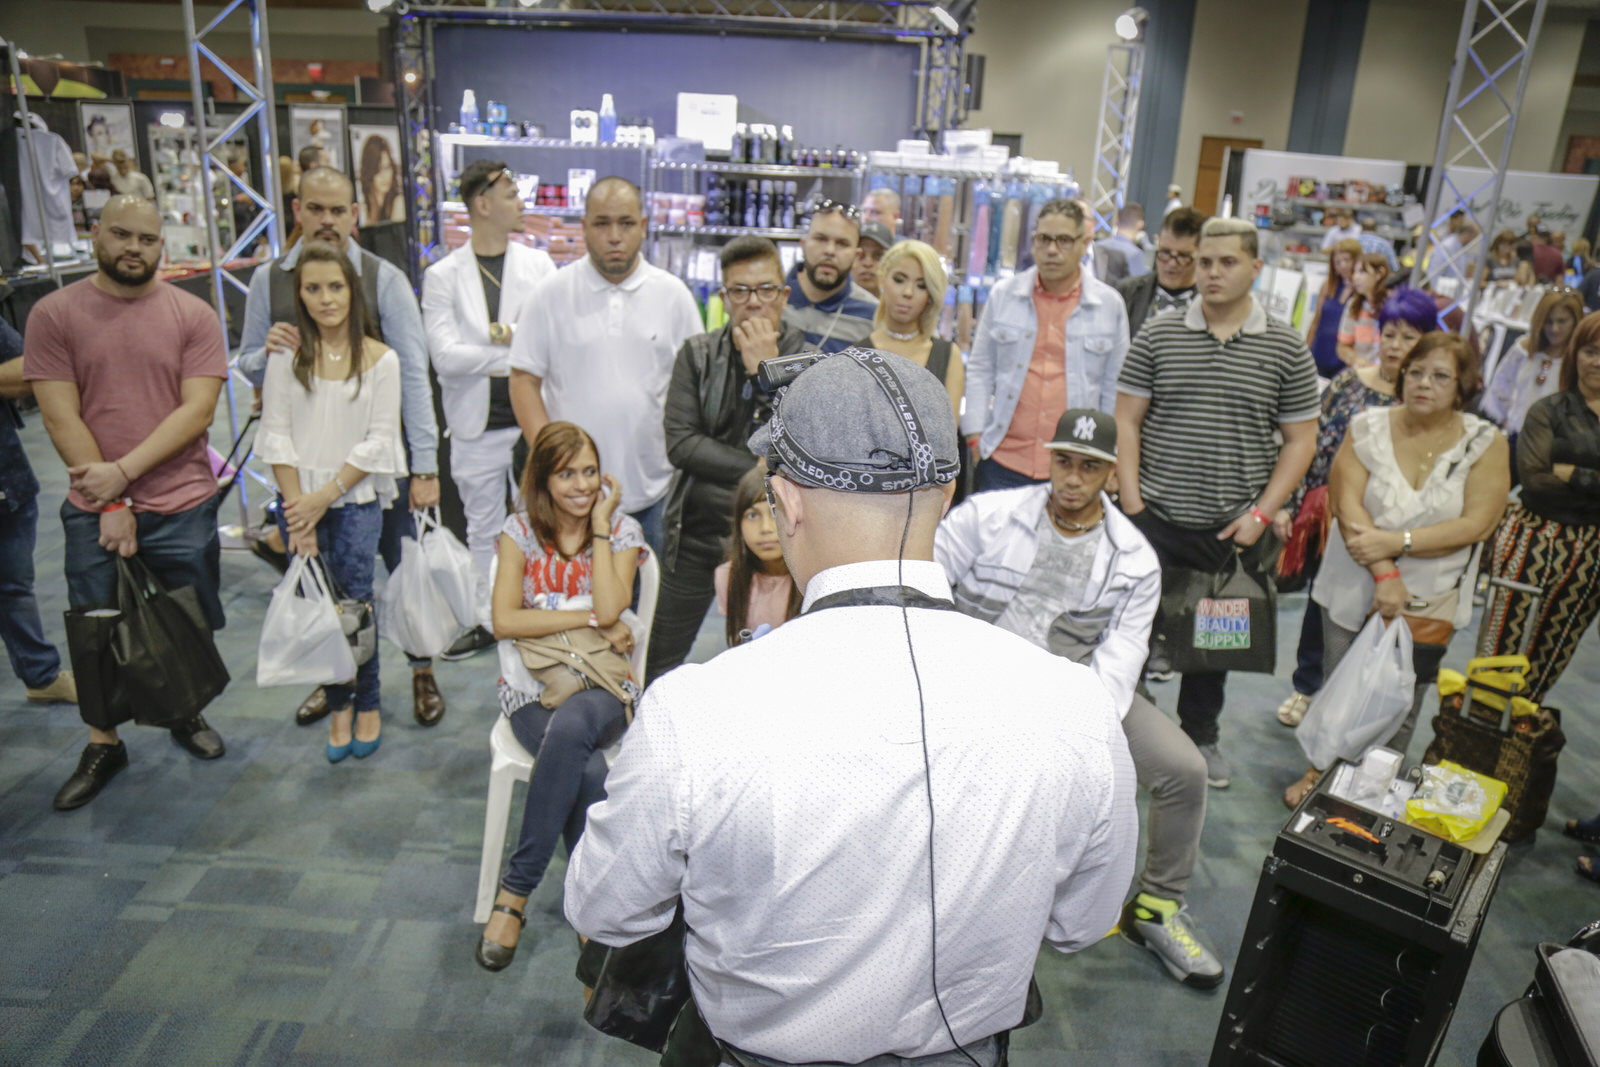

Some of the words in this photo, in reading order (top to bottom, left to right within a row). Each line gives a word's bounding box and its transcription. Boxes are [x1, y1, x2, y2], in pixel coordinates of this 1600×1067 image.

[874, 365, 917, 430] smartLED
[779, 439, 825, 479] smartLED
[1195, 632, 1248, 648] SUPPLY
